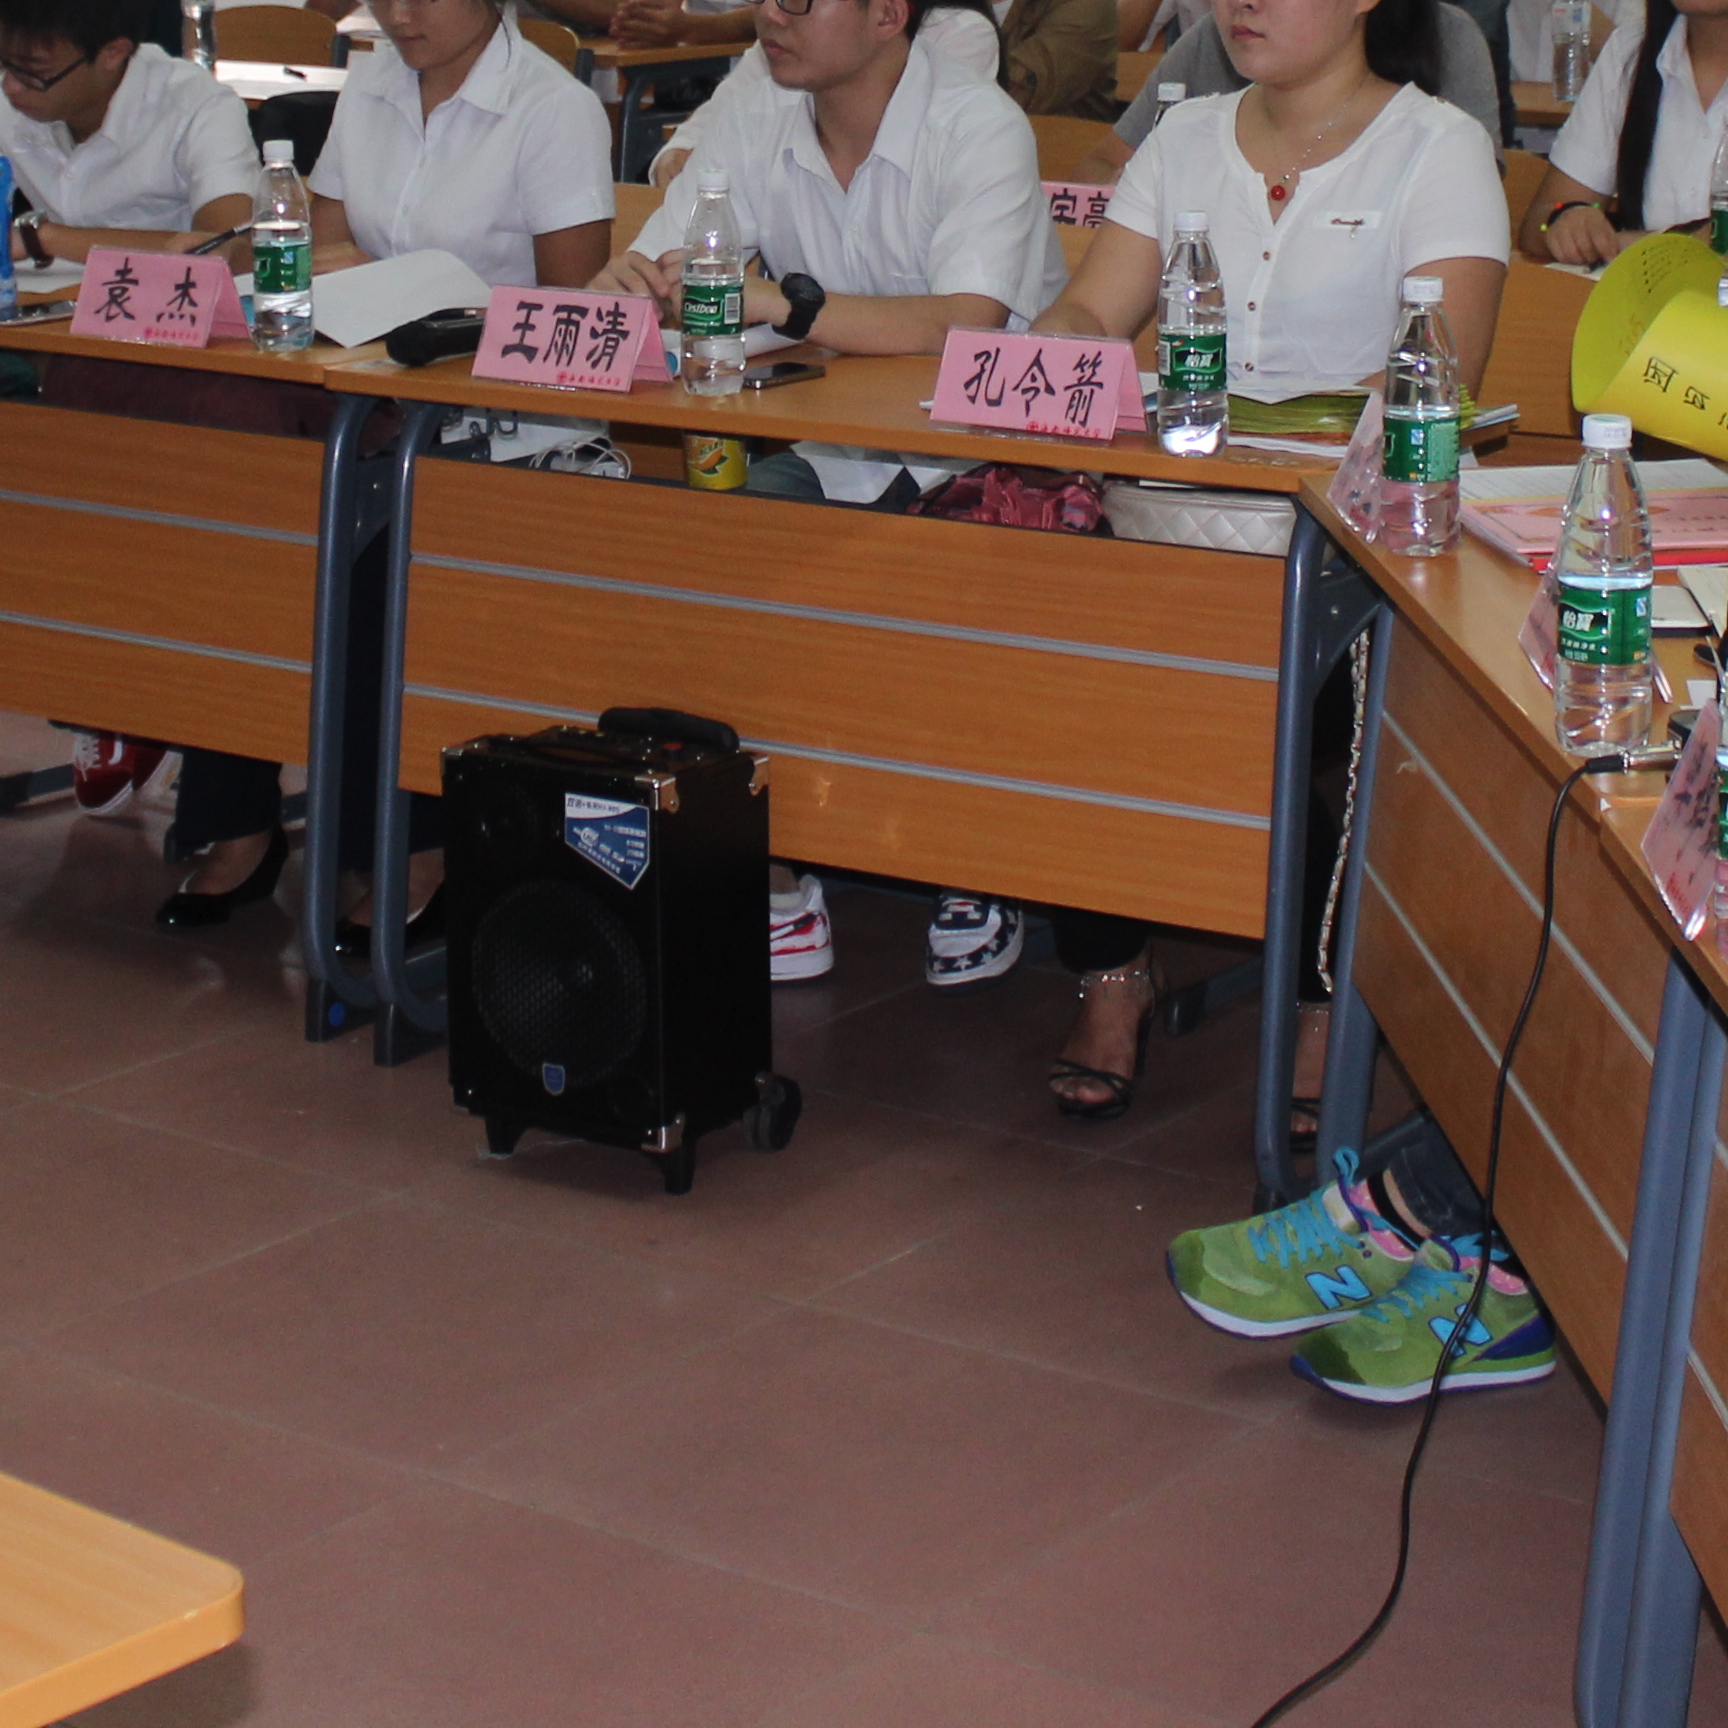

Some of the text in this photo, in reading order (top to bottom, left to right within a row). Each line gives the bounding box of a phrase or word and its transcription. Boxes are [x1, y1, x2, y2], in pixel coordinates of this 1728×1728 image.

[93, 256, 199, 327] 袁杰
[500, 300, 631, 373] 王雨清
[962, 346, 1105, 428] 孔令箭
[1305, 1265, 1372, 1311] N
